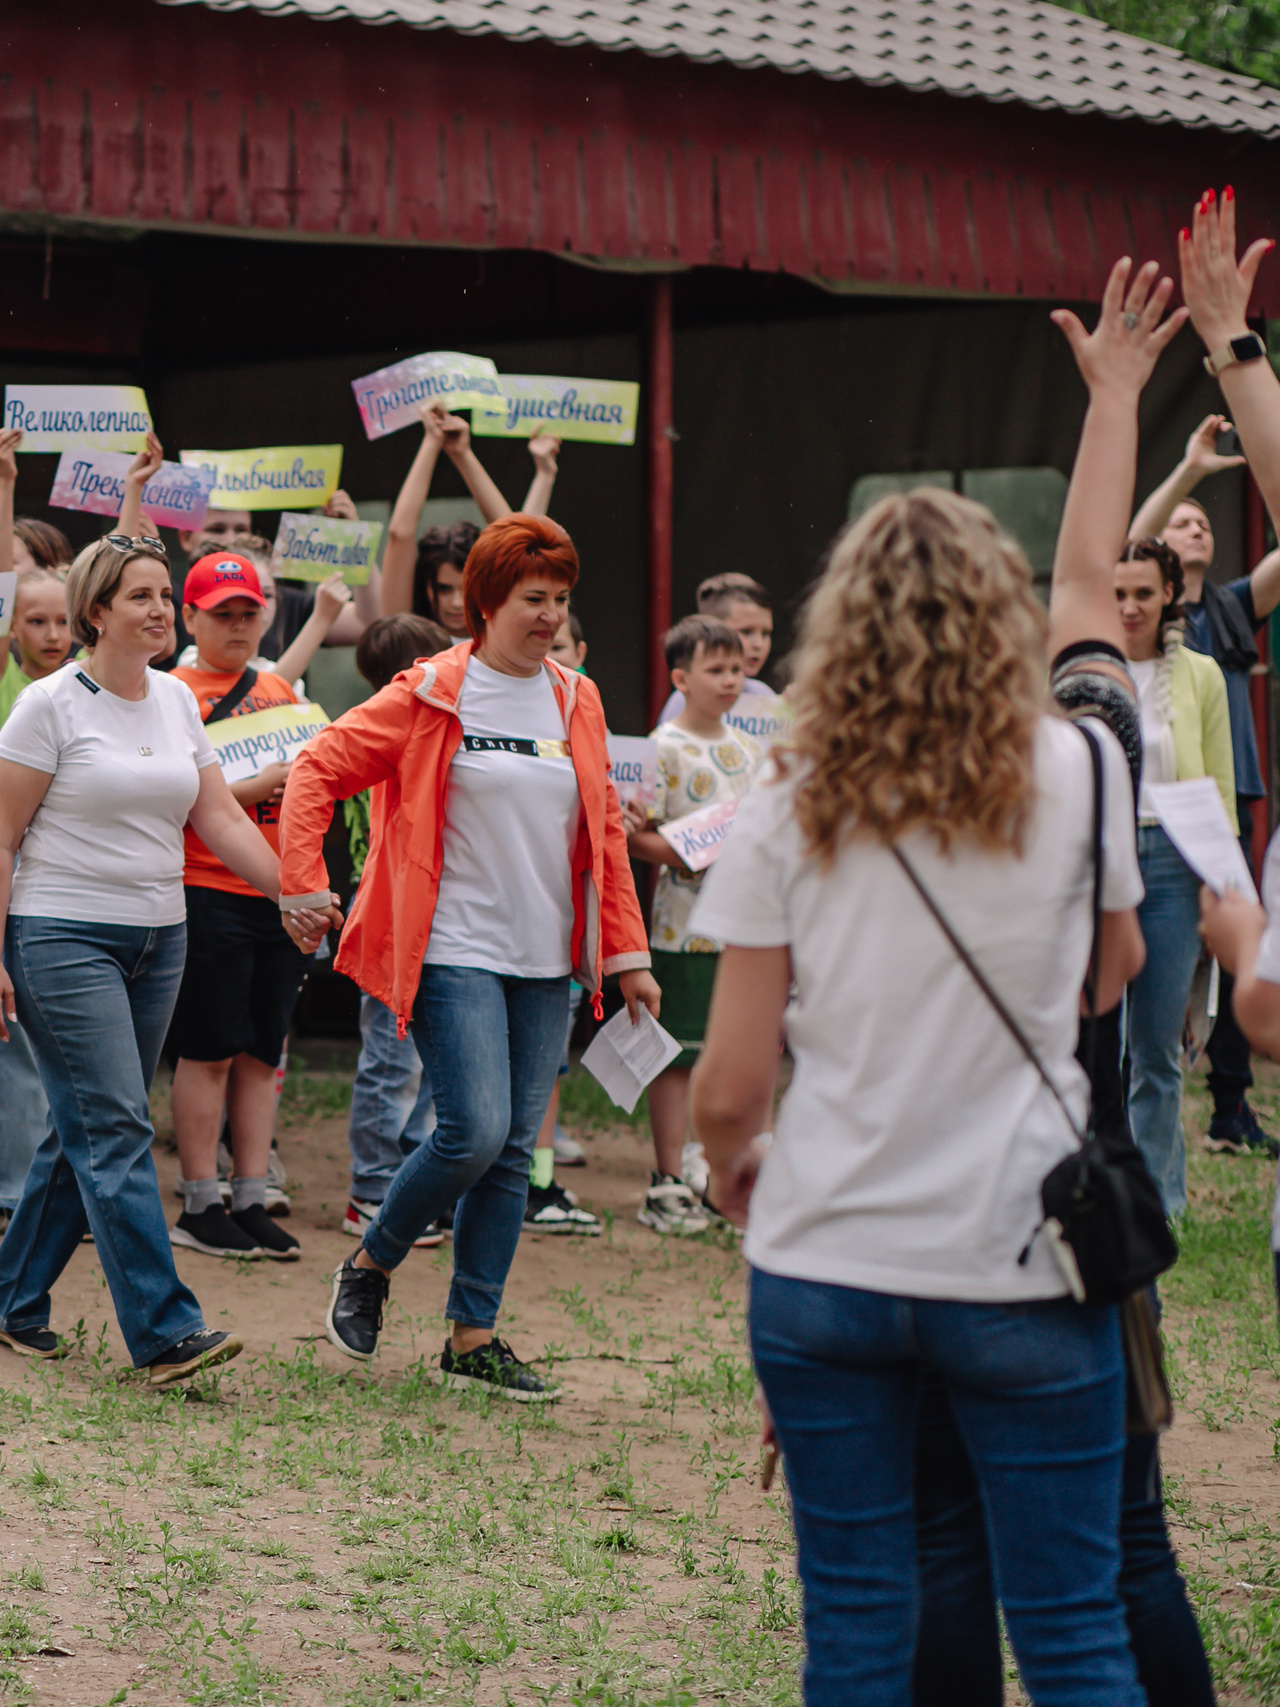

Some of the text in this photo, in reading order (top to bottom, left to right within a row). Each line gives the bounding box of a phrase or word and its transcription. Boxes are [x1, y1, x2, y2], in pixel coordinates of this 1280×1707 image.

[6, 399, 151, 432] Великолепная
[484, 388, 623, 430] ушевная
[73, 460, 194, 512] Прексная
[214, 572, 246, 583] LADA
[471, 738, 518, 752] CHIC
